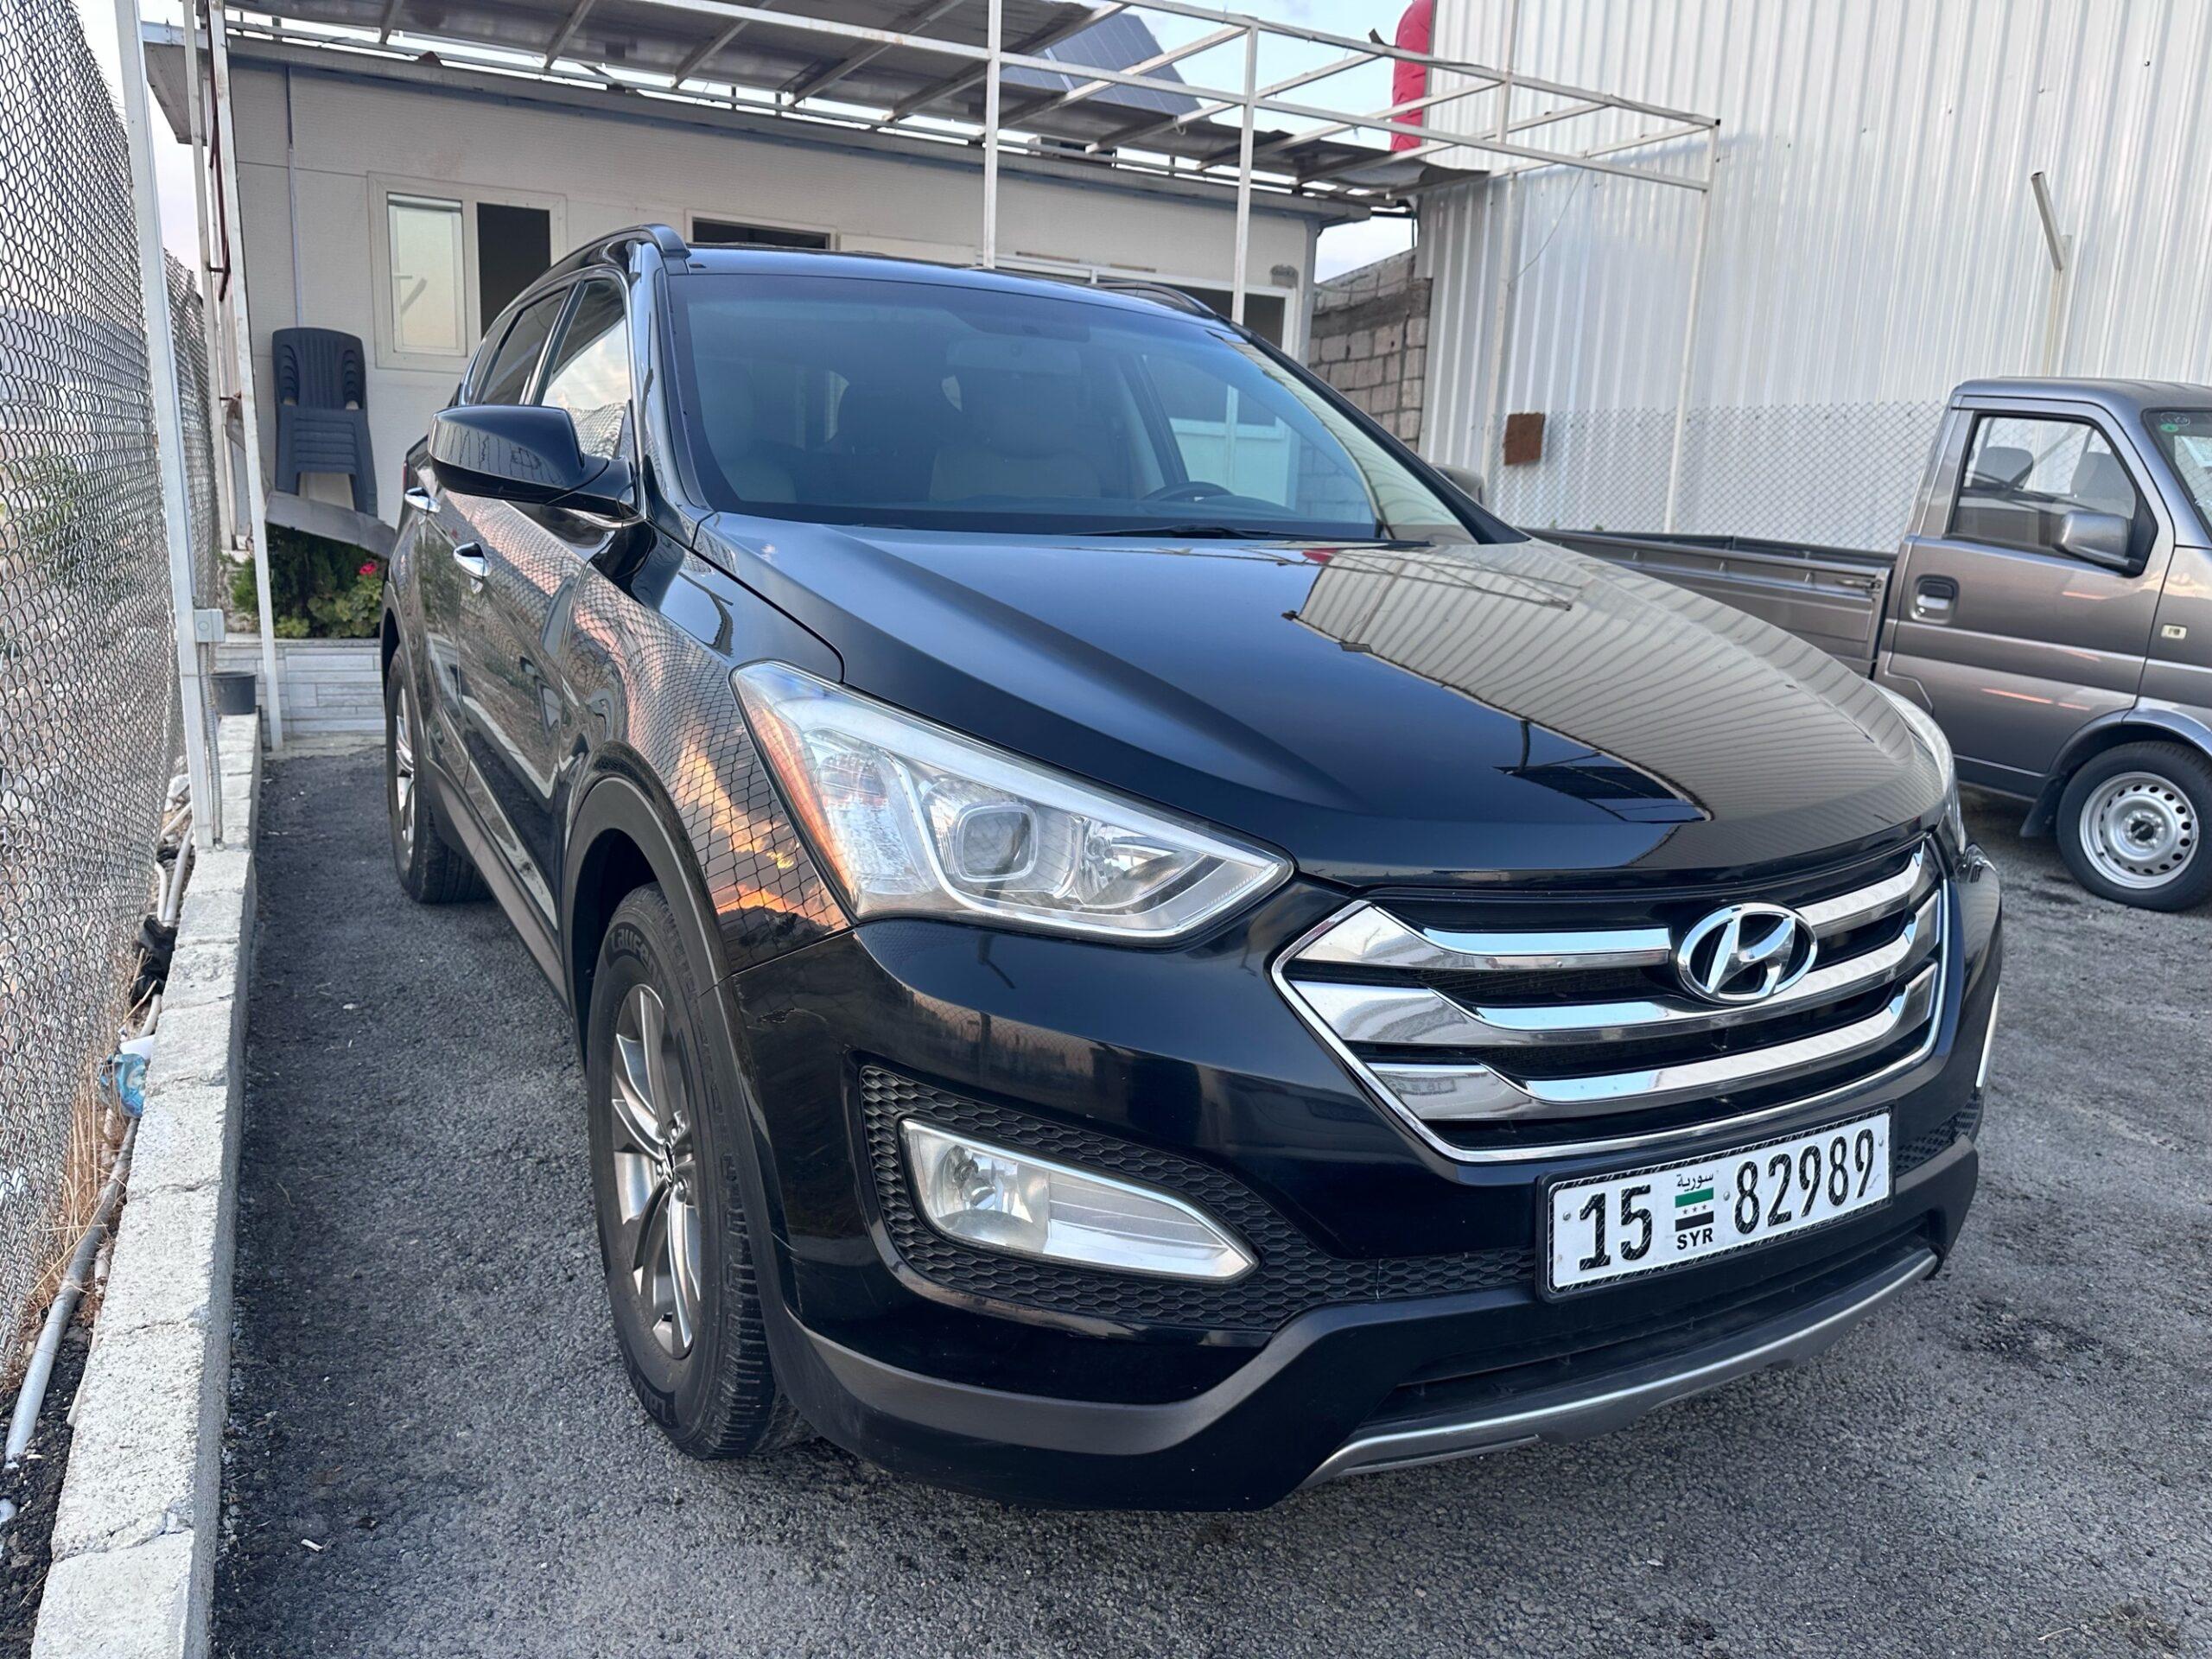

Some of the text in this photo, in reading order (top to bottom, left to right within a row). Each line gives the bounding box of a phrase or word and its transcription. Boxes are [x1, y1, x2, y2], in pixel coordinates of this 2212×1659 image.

[1676, 1173, 1714, 1192] سورية
[1579, 1128, 1875, 1270] 15 82989
[1676, 1227, 1713, 1250] SYR
